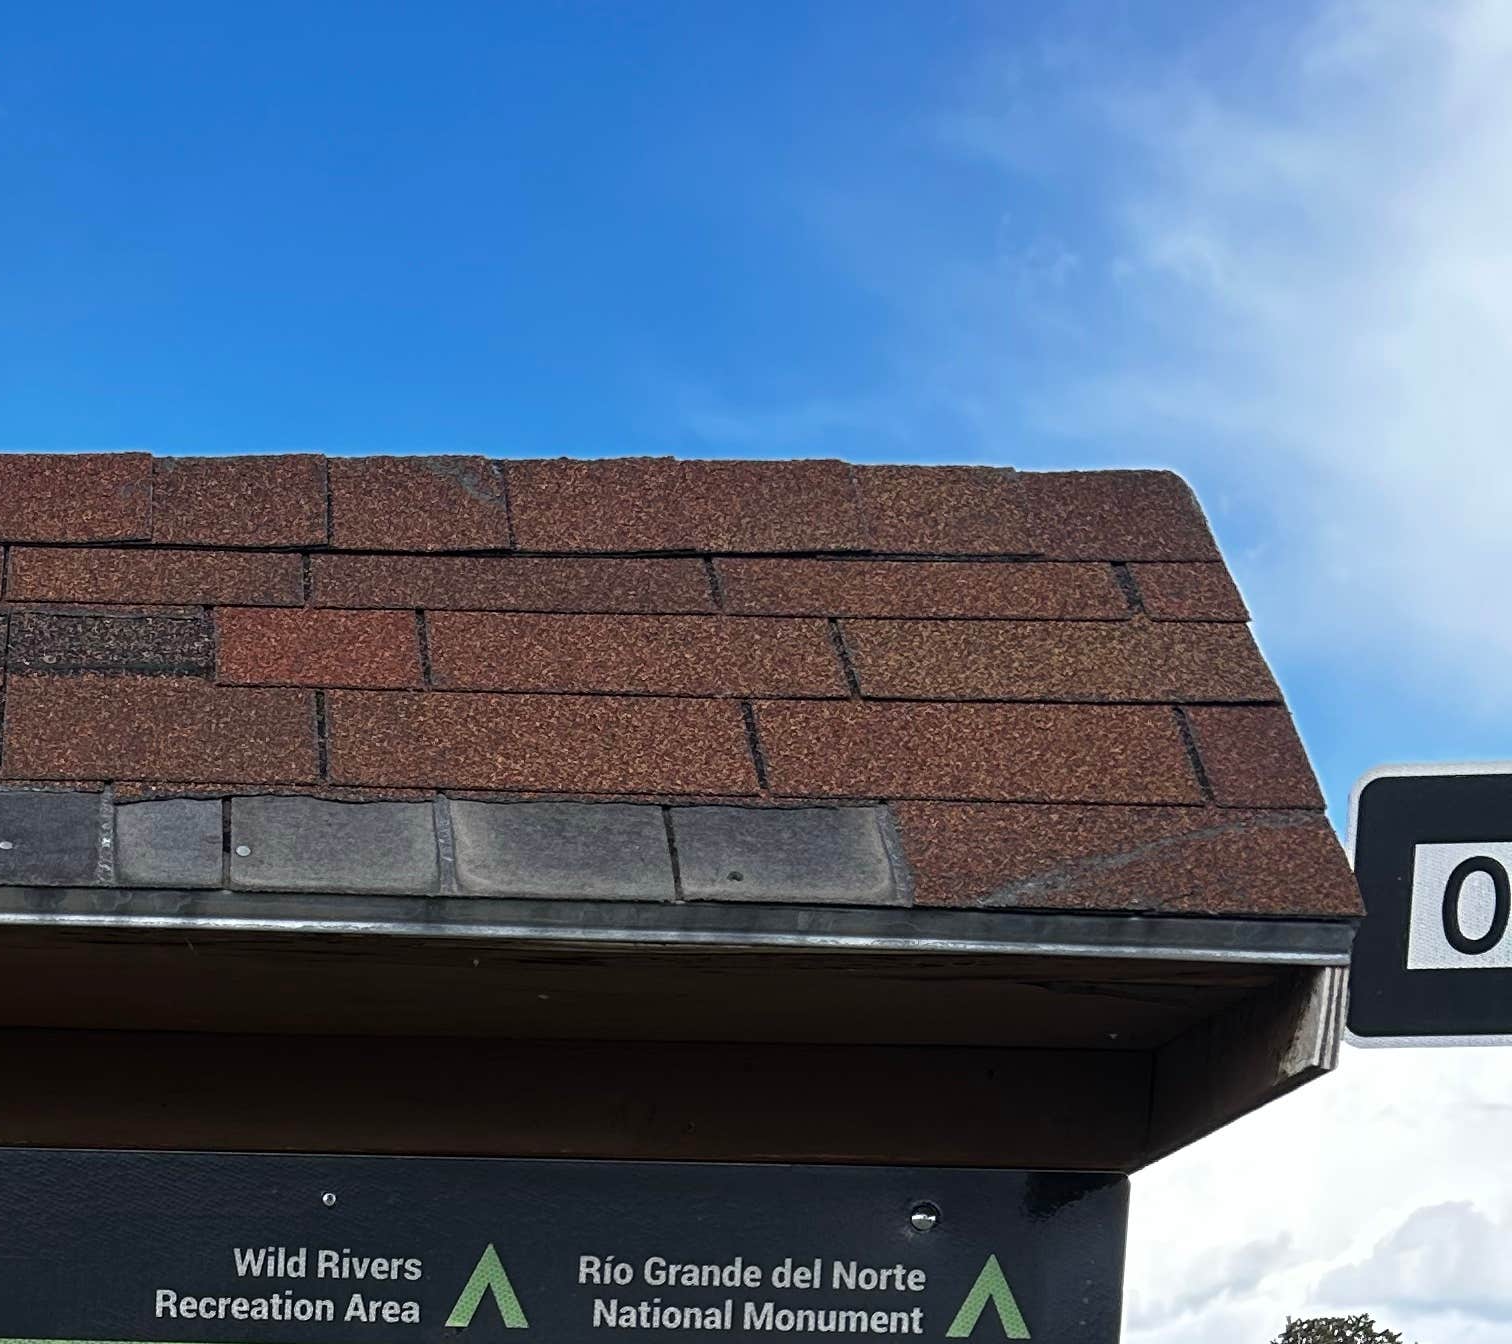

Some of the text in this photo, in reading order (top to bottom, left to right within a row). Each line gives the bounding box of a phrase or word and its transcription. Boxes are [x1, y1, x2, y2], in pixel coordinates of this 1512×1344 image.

[234, 1246, 422, 1280] Wild Rivers
[579, 1256, 926, 1291] Río Grande del Norte
[156, 1289, 419, 1323] Recreation Area
[593, 1298, 923, 1334] National Monument
